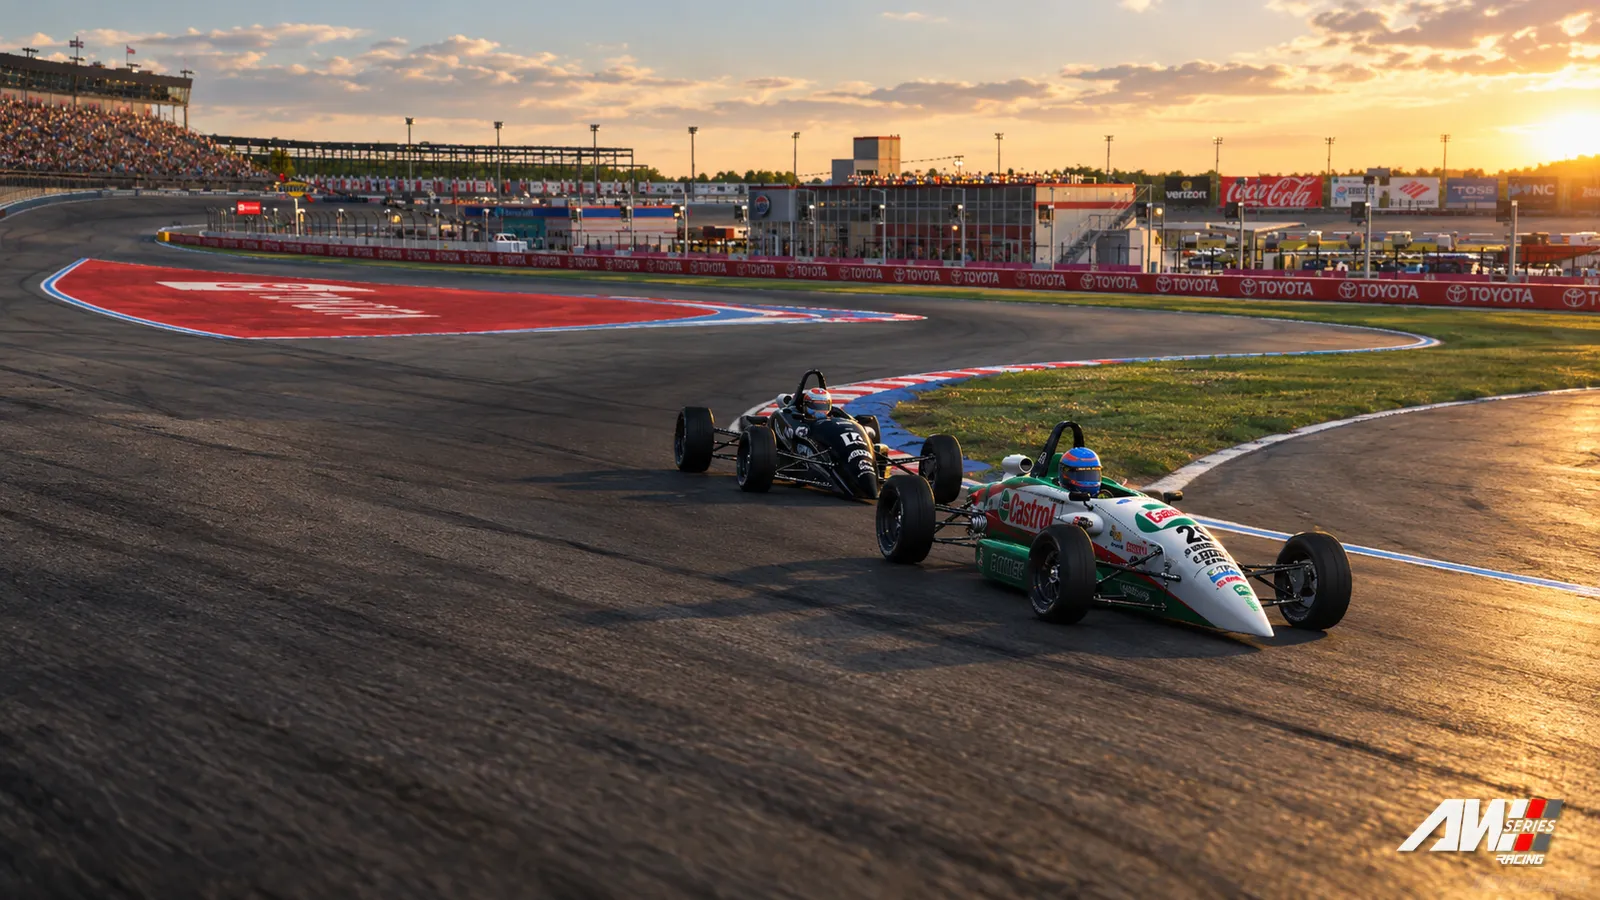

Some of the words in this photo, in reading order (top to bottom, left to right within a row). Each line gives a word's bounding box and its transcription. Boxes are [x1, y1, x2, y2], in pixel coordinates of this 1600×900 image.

[1166, 190, 1207, 199] verizon
[1226, 177, 1317, 206] Coca-Cola
[797, 265, 828, 277] TOYOTA
[850, 267, 883, 279] TOYOTA
[906, 269, 941, 282] TOYOTA
[963, 271, 999, 284] TOYOTA
[1028, 273, 1066, 286] TOYOTA
[1096, 275, 1139, 289] TOYOTA
[1173, 278, 1220, 292] TOYOTA
[1259, 280, 1314, 295] TOYOTA
[1359, 283, 1419, 299] TOYOTA
[1469, 286, 1534, 303] TOYOTA
[1009, 493, 1057, 530] Castrol
